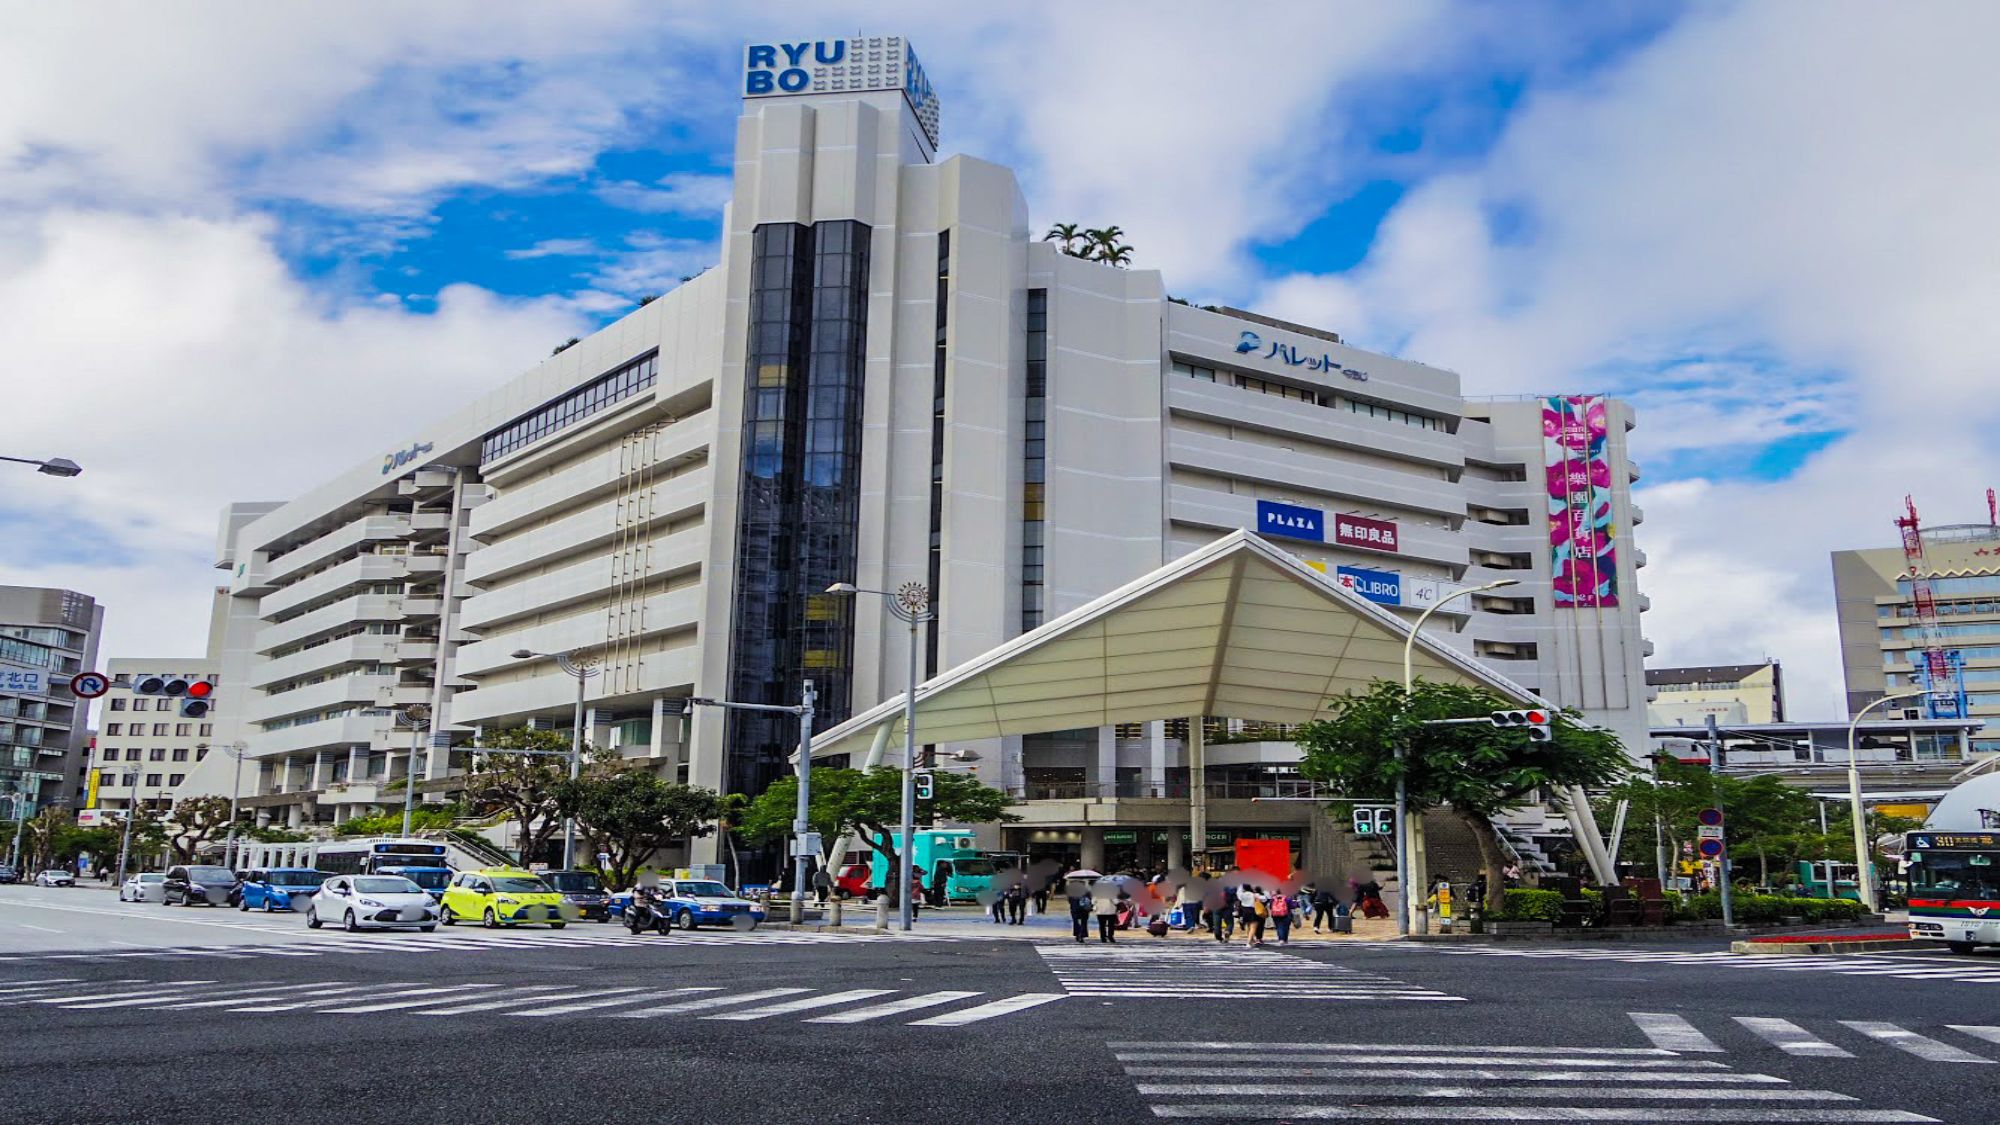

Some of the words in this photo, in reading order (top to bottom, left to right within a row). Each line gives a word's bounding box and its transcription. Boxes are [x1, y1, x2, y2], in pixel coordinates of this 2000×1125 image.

[748, 40, 845, 68] RYU
[747, 68, 809, 95] BO
[1267, 512, 1315, 531] PLAZA
[1339, 522, 1396, 546] 無印良品
[1339, 574, 1354, 589] 本
[1363, 580, 1398, 597] LIBRO
[1415, 588, 1433, 601] 4C
